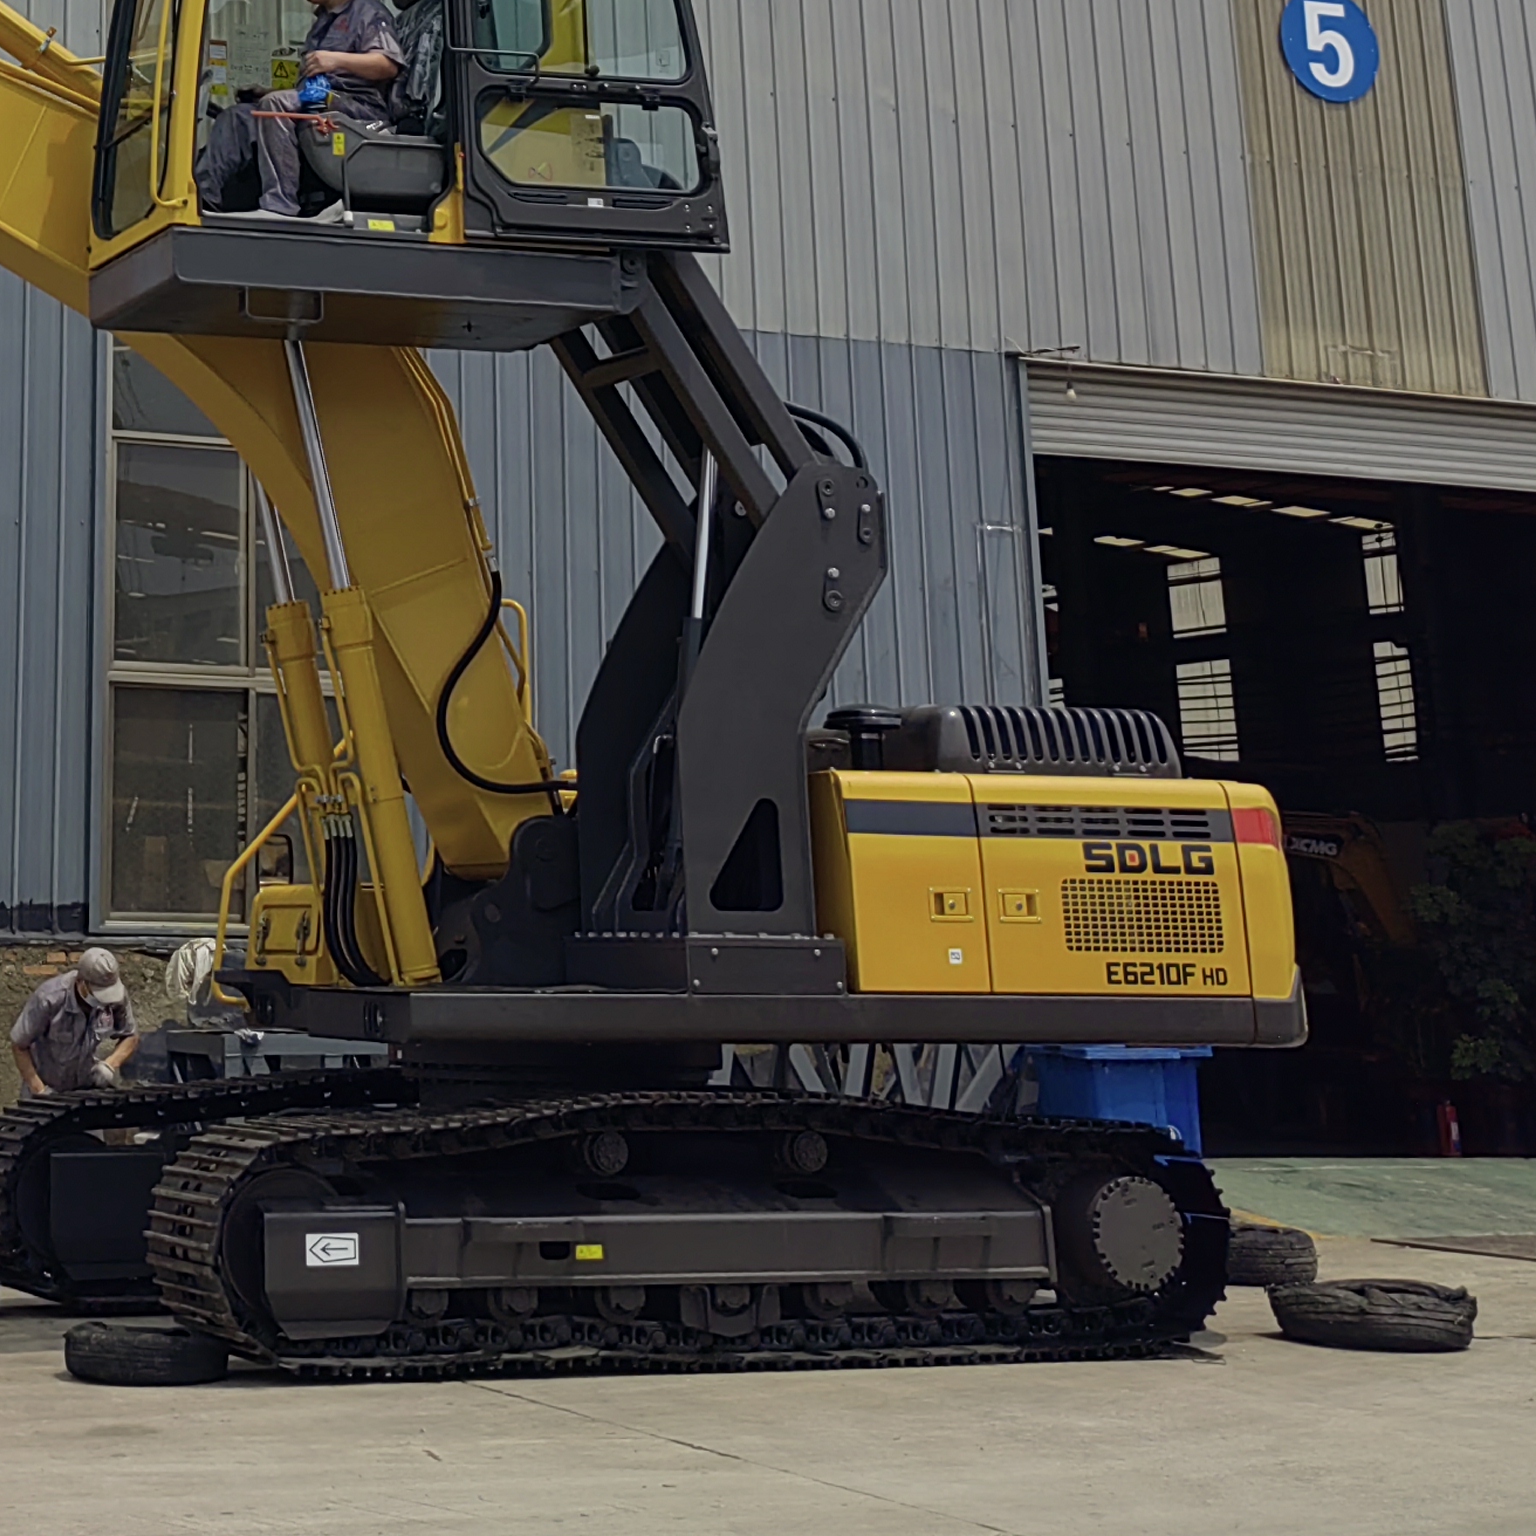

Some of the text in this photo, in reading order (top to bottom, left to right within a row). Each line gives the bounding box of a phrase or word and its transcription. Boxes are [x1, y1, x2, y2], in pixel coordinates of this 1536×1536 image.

[1303, 0, 1354, 88] 5
[1082, 842, 1214, 875] SDLG
[1106, 962, 1228, 986] E6210F HD
